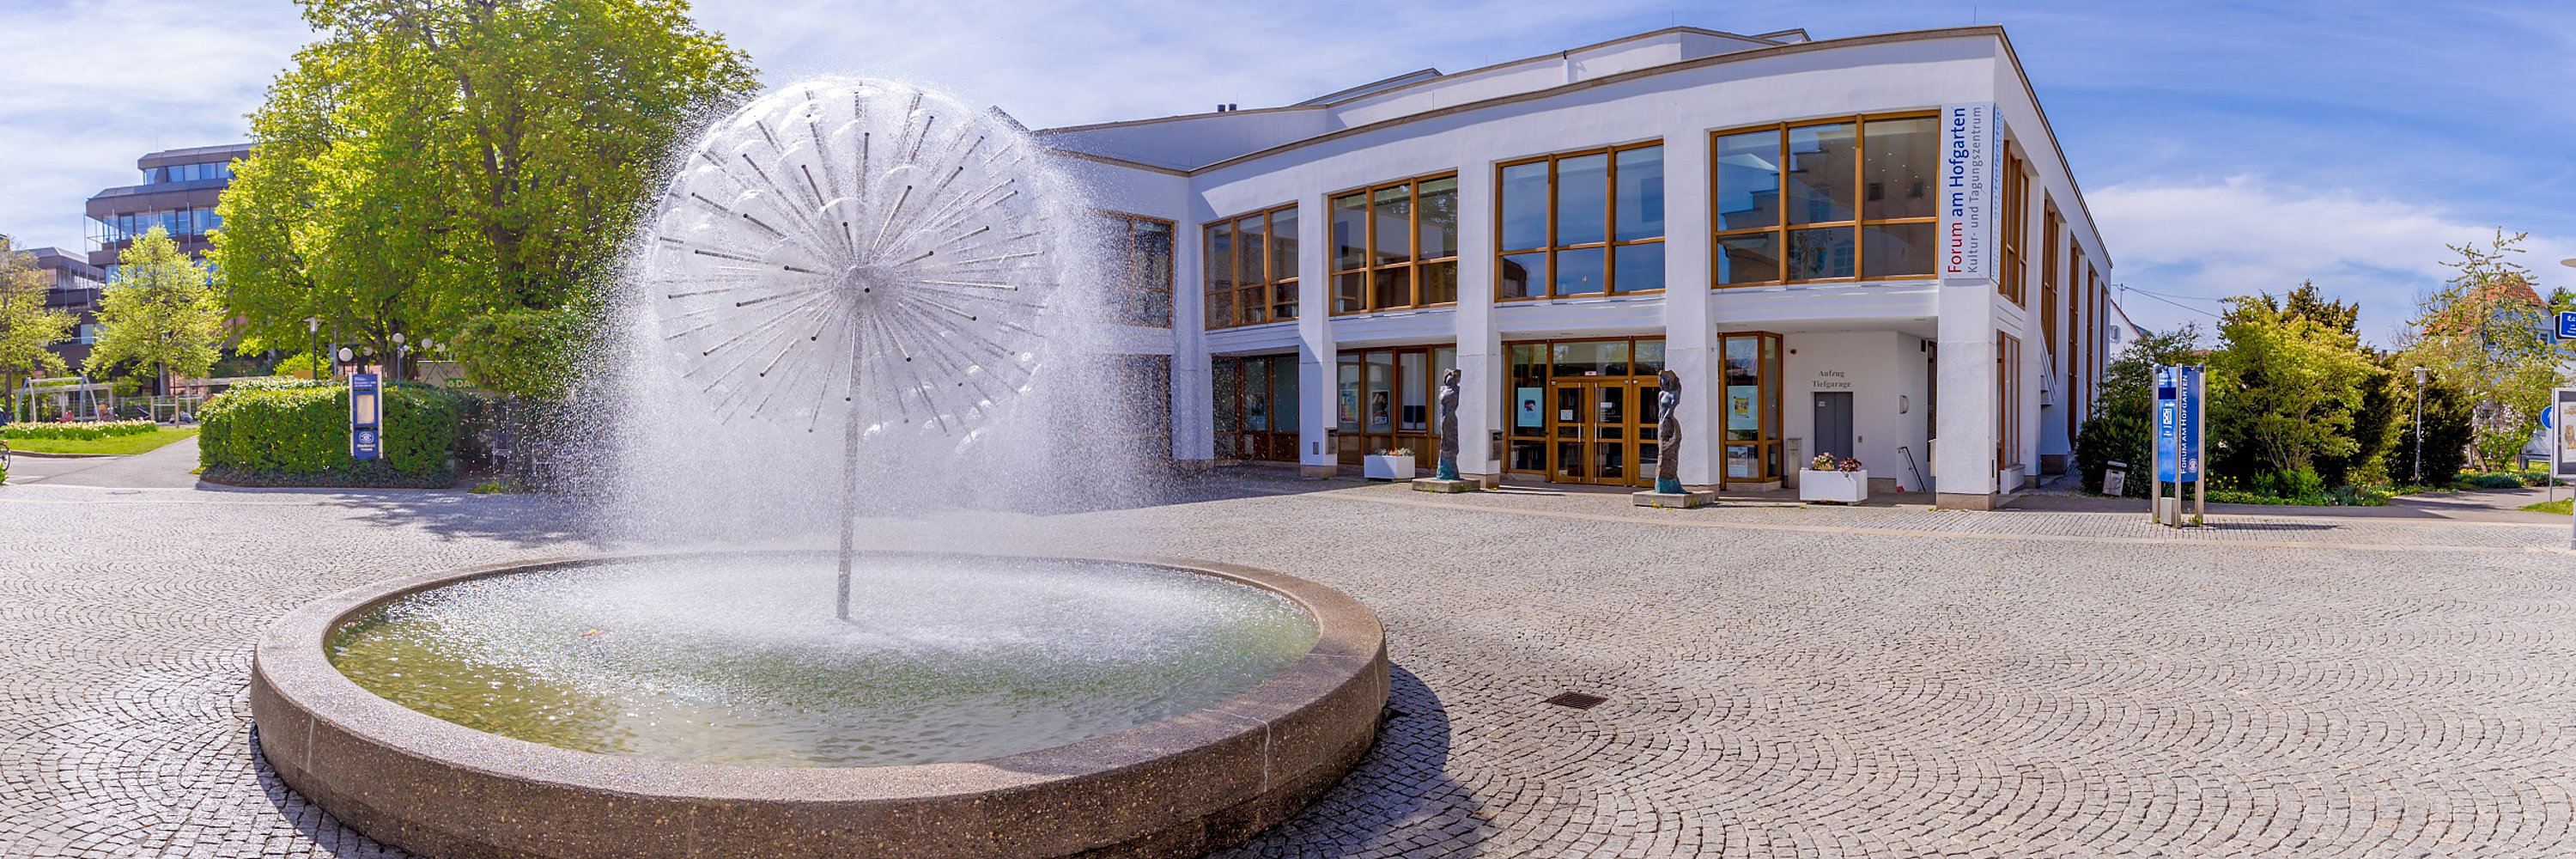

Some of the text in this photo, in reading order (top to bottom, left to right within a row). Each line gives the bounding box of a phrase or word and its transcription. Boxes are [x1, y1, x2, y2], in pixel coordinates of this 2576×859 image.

[1947, 107, 1969, 273] Forum am Hofgarten
[1967, 107, 1983, 273] Kultur- und Tagungszentrum
[1819, 369, 1845, 378] Aufzug
[1812, 380, 1851, 388] Tiefgarage
[2181, 427, 2187, 442] AM
